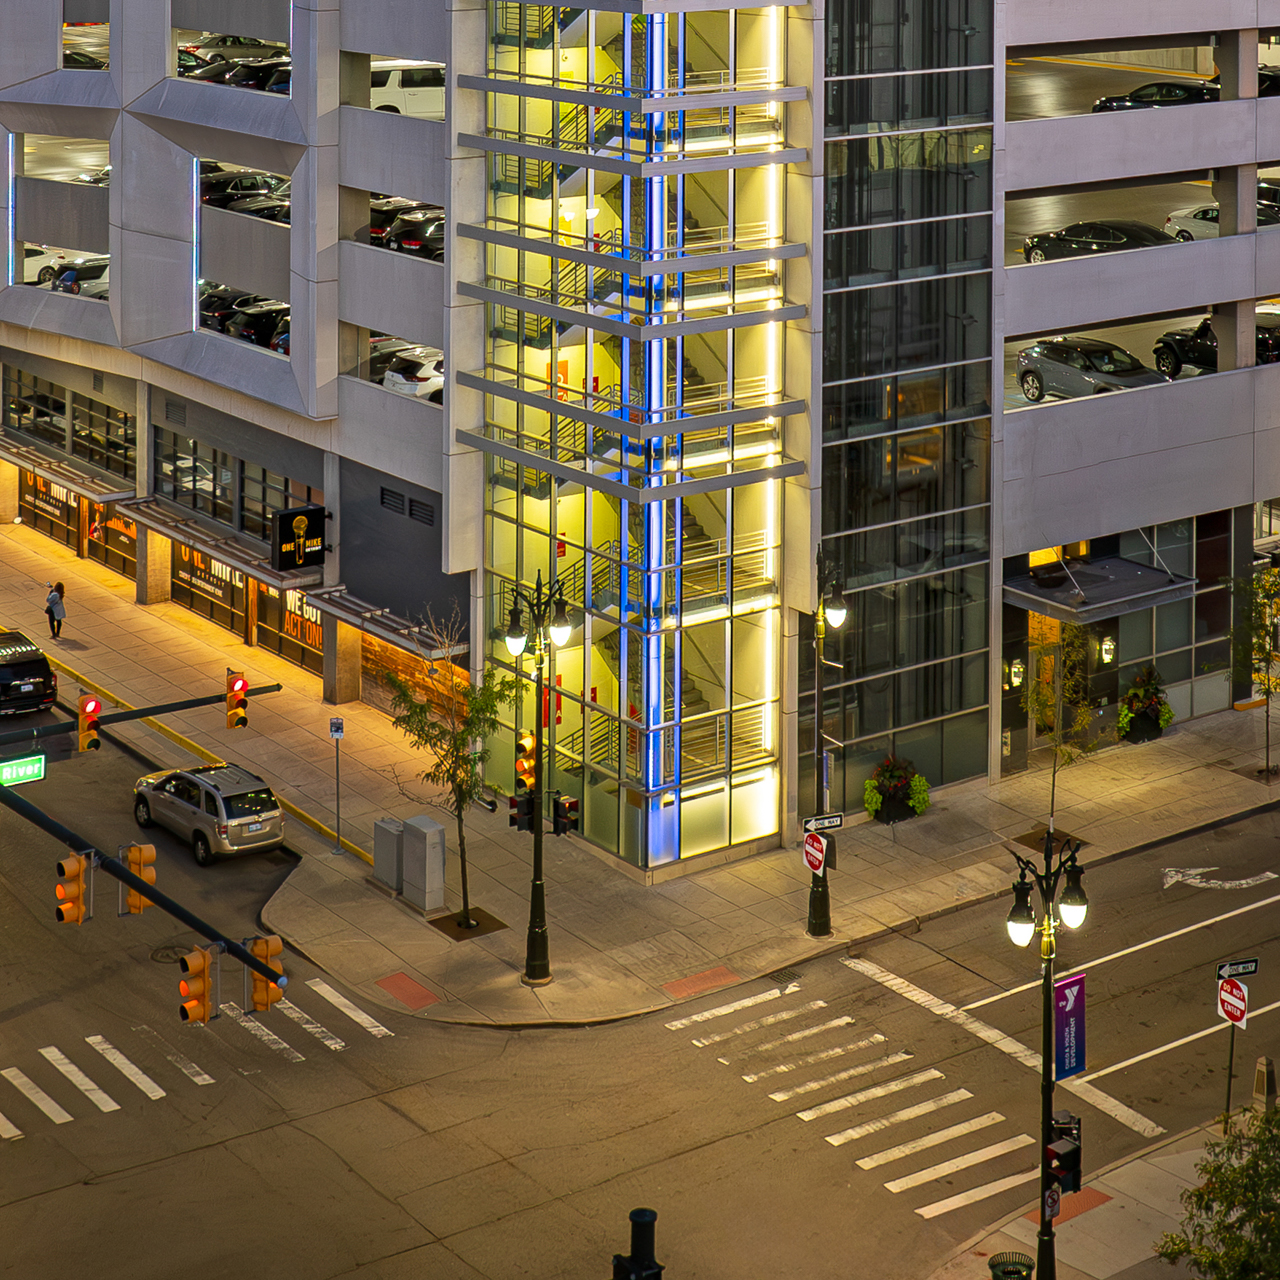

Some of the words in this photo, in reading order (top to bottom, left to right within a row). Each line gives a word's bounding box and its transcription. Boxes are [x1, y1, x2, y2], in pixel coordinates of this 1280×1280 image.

[281, 542, 295, 553] ONE
[305, 537, 322, 548] MIKE
[286, 590, 302, 615] WE
[3, 763, 41, 780] River
[827, 818, 839, 826] WAY
[1241, 963, 1254, 972] WAY
[1223, 982, 1231, 993] DO
[1232, 988, 1244, 1000] NOT
[1224, 1002, 1241, 1018] ENTER
